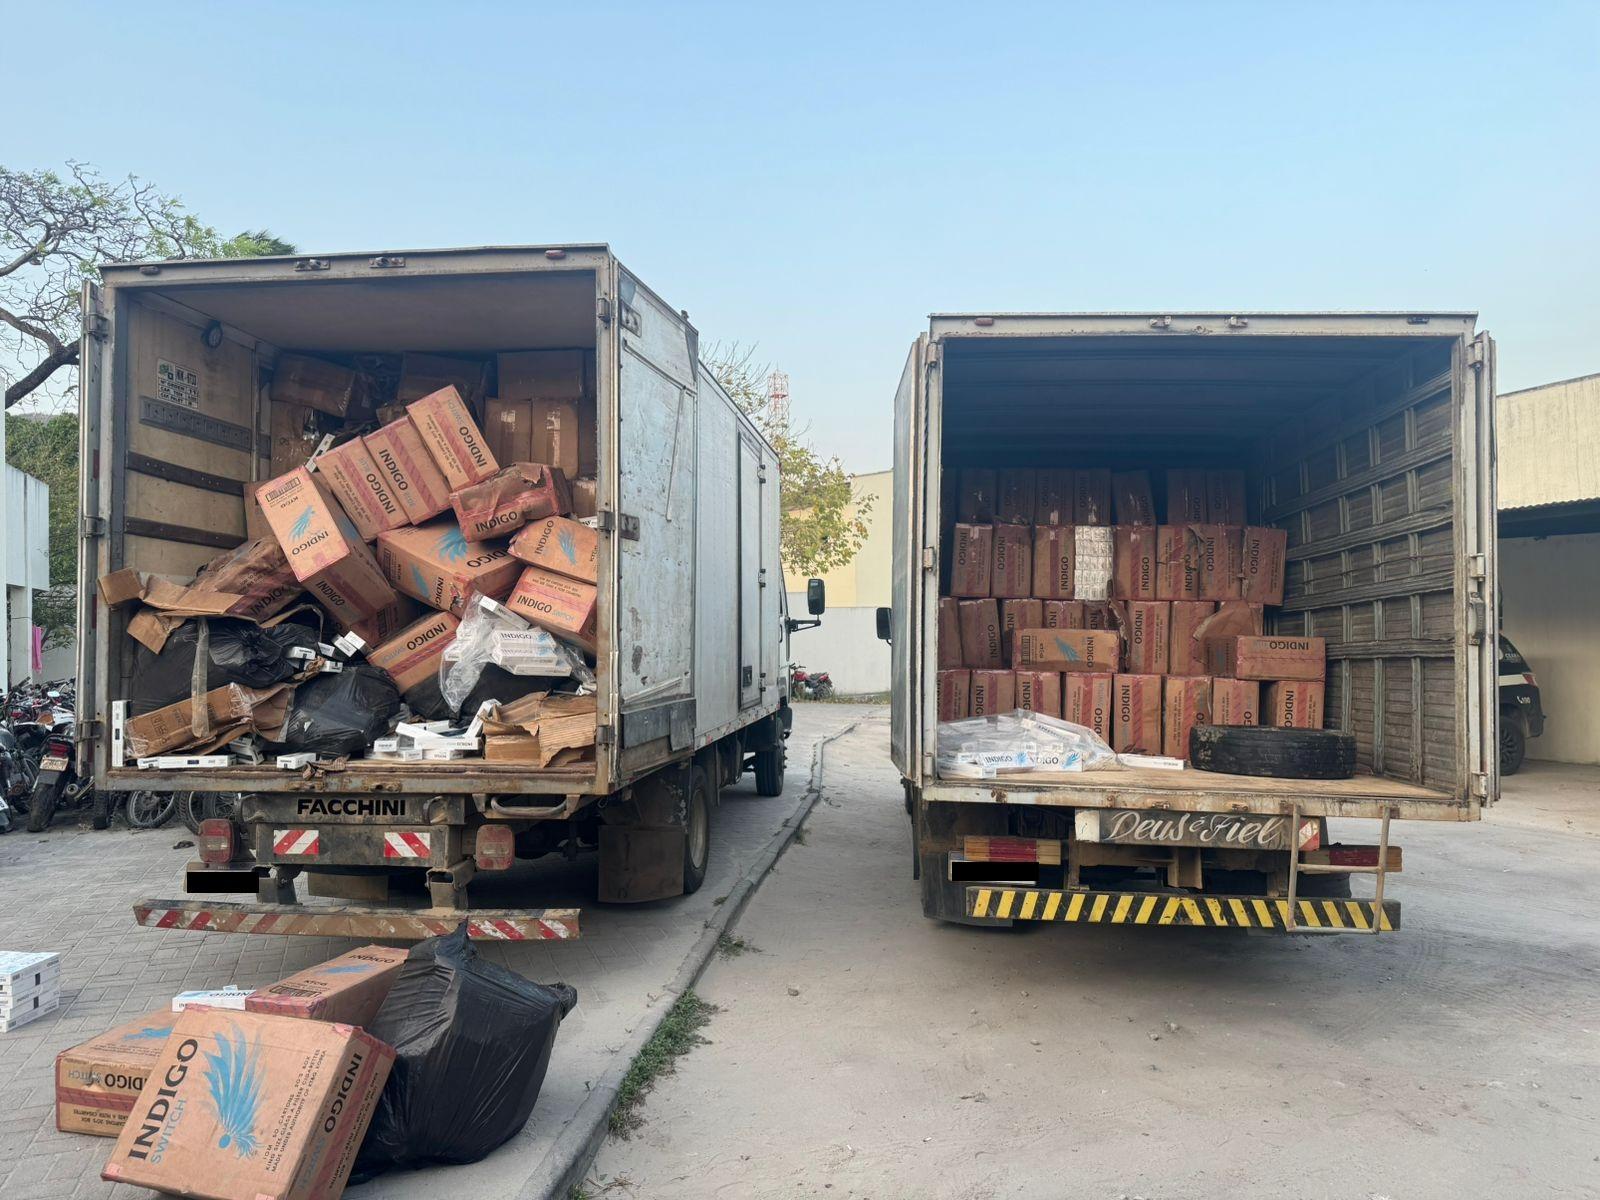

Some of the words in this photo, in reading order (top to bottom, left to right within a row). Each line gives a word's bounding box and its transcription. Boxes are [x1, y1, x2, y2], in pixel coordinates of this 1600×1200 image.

[459, 426, 488, 468] INDIGO
[379, 449, 408, 491] INDIGO
[366, 473, 396, 514] INDIGO
[475, 511, 518, 532] INDIGO
[534, 520, 554, 555] INDIGO
[292, 531, 329, 556] INDIGO
[467, 548, 510, 568] DIGO
[958, 532, 968, 566] INDIGO
[998, 536, 1006, 570] INDIGO
[1250, 540, 1260, 574] INDIGO
[1061, 556, 1069, 590] INDIGO
[1142, 557, 1150, 591] INDIGO
[316, 580, 345, 606] INDIGO
[517, 595, 552, 613] INDIGO
[407, 622, 447, 651] INDIGO
[1090, 613, 1098, 629] IND
[1135, 610, 1143, 645] INDIGO
[988, 624, 998, 658] INDIGO
[1269, 641, 1310, 650] INDIGO
[975, 685, 984, 716] INDIG
[1022, 681, 1031, 711] INDIG
[1121, 685, 1130, 722] INDIGO
[1094, 708, 1103, 738] DIGO
[297, 799, 405, 815] FACCHINI
[1103, 811, 1191, 841] Deus
[1200, 814, 1285, 844] Fiel
[348, 953, 395, 964] INDIGO
[104, 1073, 147, 1091] DIGO
[279, 1094, 295, 1124] CARTONS
[302, 1056, 311, 1070] BOX
[324, 1053, 363, 1133] INDIGO
[128, 1039, 198, 1160] INDIGO
[266, 1152, 275, 1171] KING
[274, 1136, 283, 1152] SIZE
[302, 1049, 321, 1086] CIGARETTES
[272, 1153, 283, 1172] MADE
[280, 1132, 292, 1152] UNDER
[290, 1098, 305, 1132] AUTHORITY
[303, 1089, 309, 1097] OF
[316, 1050, 327, 1070] KOREA
[150, 1099, 187, 1163] SWITCH
